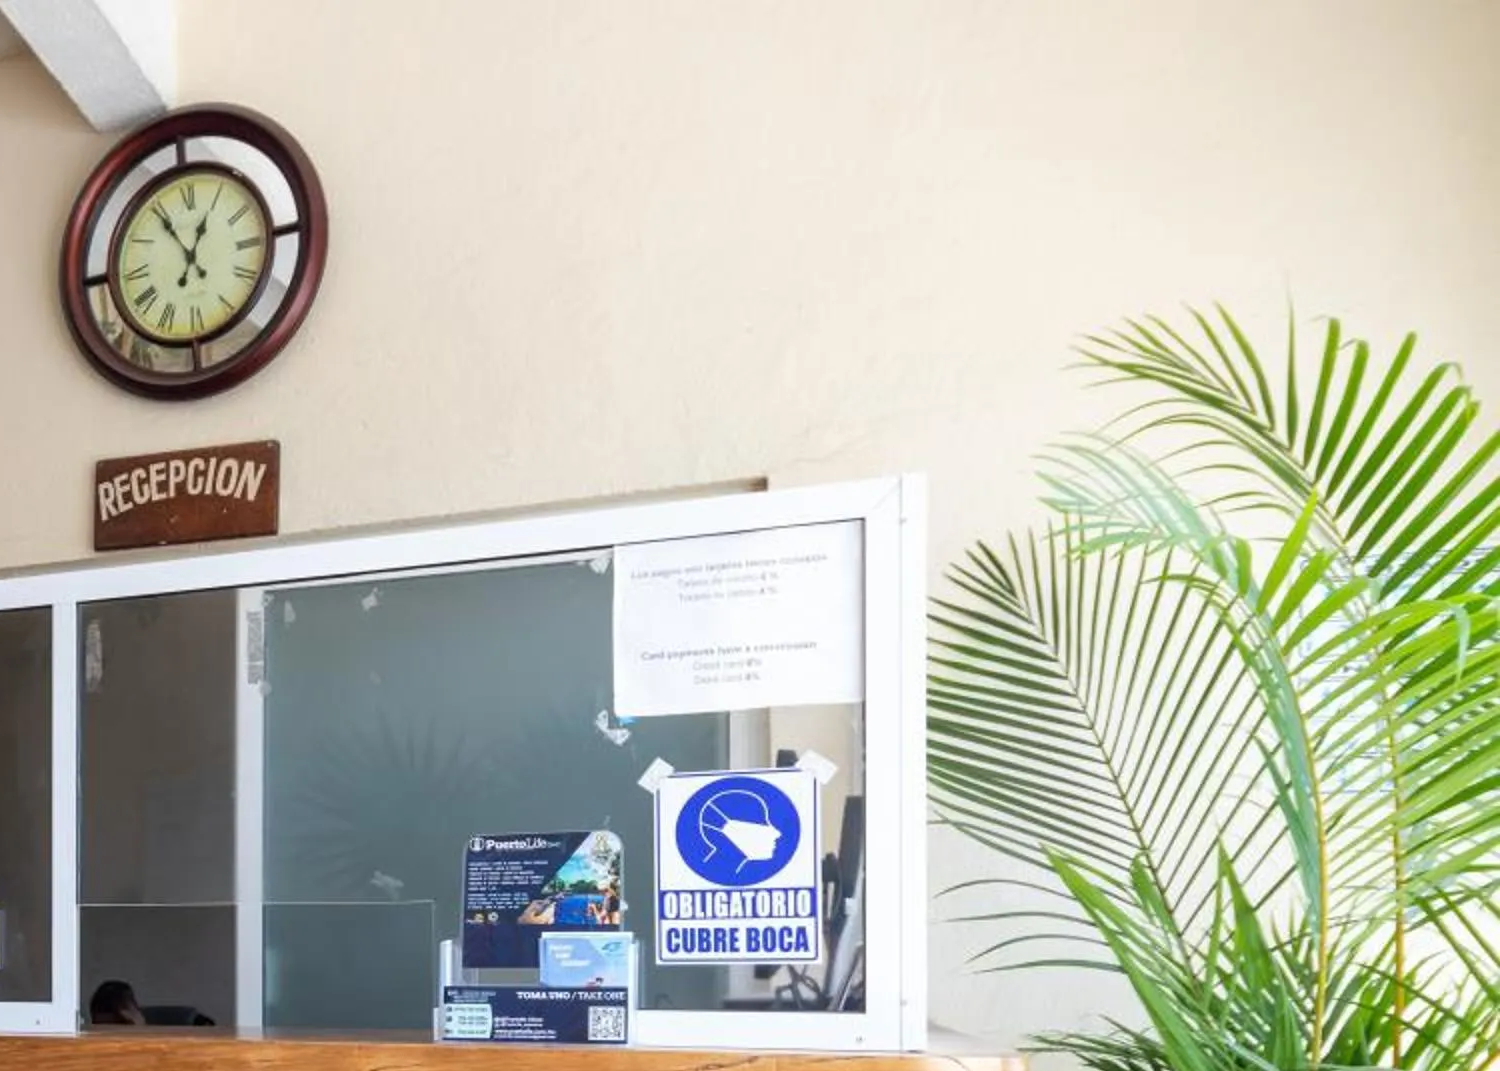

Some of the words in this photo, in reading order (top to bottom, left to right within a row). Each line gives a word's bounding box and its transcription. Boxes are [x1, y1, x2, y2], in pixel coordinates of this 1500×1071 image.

[98, 456, 267, 521] RECEPCION
[663, 889, 812, 918] OBLIGATORIO
[666, 927, 740, 953] CUBRE
[746, 926, 810, 953] BOCA
